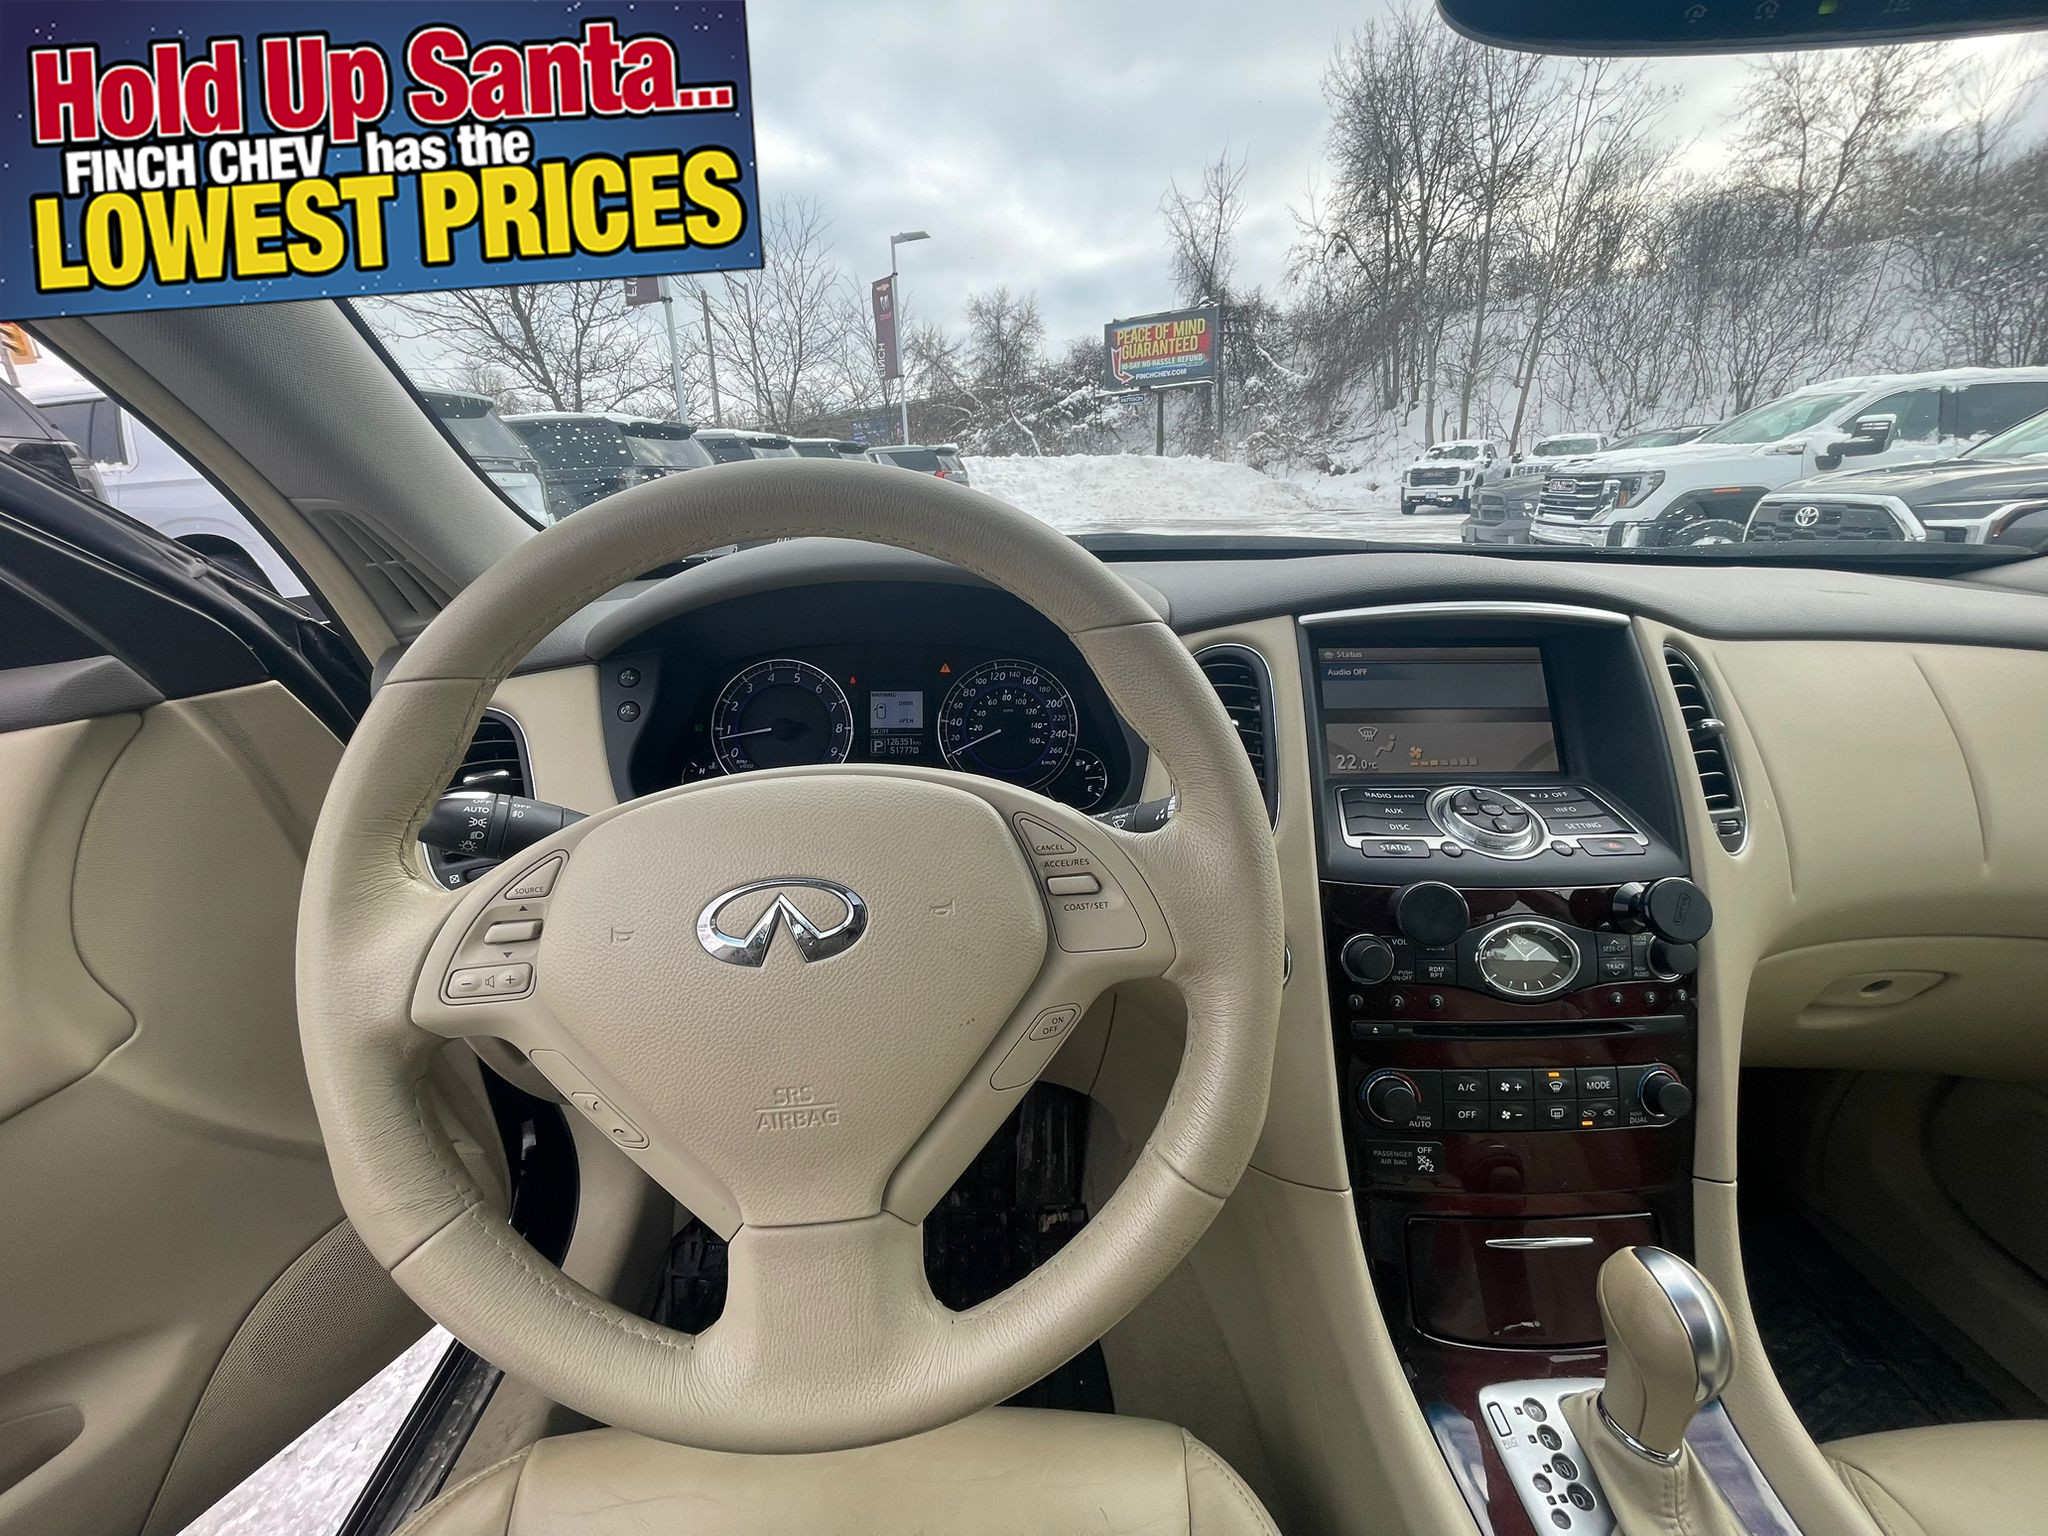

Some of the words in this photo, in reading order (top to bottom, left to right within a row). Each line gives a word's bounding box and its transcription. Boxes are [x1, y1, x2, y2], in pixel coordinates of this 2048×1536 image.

[1117, 326, 1152, 345] PEACE
[1155, 323, 1170, 340] OF
[1173, 318, 1206, 336] MIND
[1122, 335, 1198, 360] GUARANTEED
[1177, 354, 1203, 363] REFUND
[1135, 368, 1187, 380] FINCHCHEV.COM
[768, 673, 775, 682] 4
[793, 673, 801, 683] 5
[990, 672, 1006, 681] 120
[1023, 676, 1038, 686] 160
[746, 684, 753, 694] 3
[815, 684, 823, 694] 6
[963, 689, 976, 698] 80
[731, 701, 739, 711] 2
[830, 702, 837, 712] 7
[1046, 700, 1062, 708] 200
[950, 718, 963, 727] 40
[835, 723, 843, 733] 8
[1050, 730, 1068, 738] 240
[731, 747, 739, 758] 0
[830, 747, 838, 757] 9
[1044, 859, 1090, 868] ACCEL/RES
[515, 886, 544, 895] SOURCE
[1064, 902, 1109, 911] COAST/SET
[1052, 1016, 1065, 1025] ON
[1043, 1026, 1058, 1035] OFF
[1457, 1083, 1476, 1092] A/C
[1586, 1081, 1611, 1090] MODE
[757, 1108, 840, 1131] AIRBAG
[1458, 1111, 1476, 1119] OFF
[1541, 1434, 1555, 1447] R
[1556, 1463, 1571, 1476] N
[1572, 1493, 1585, 1506] D
